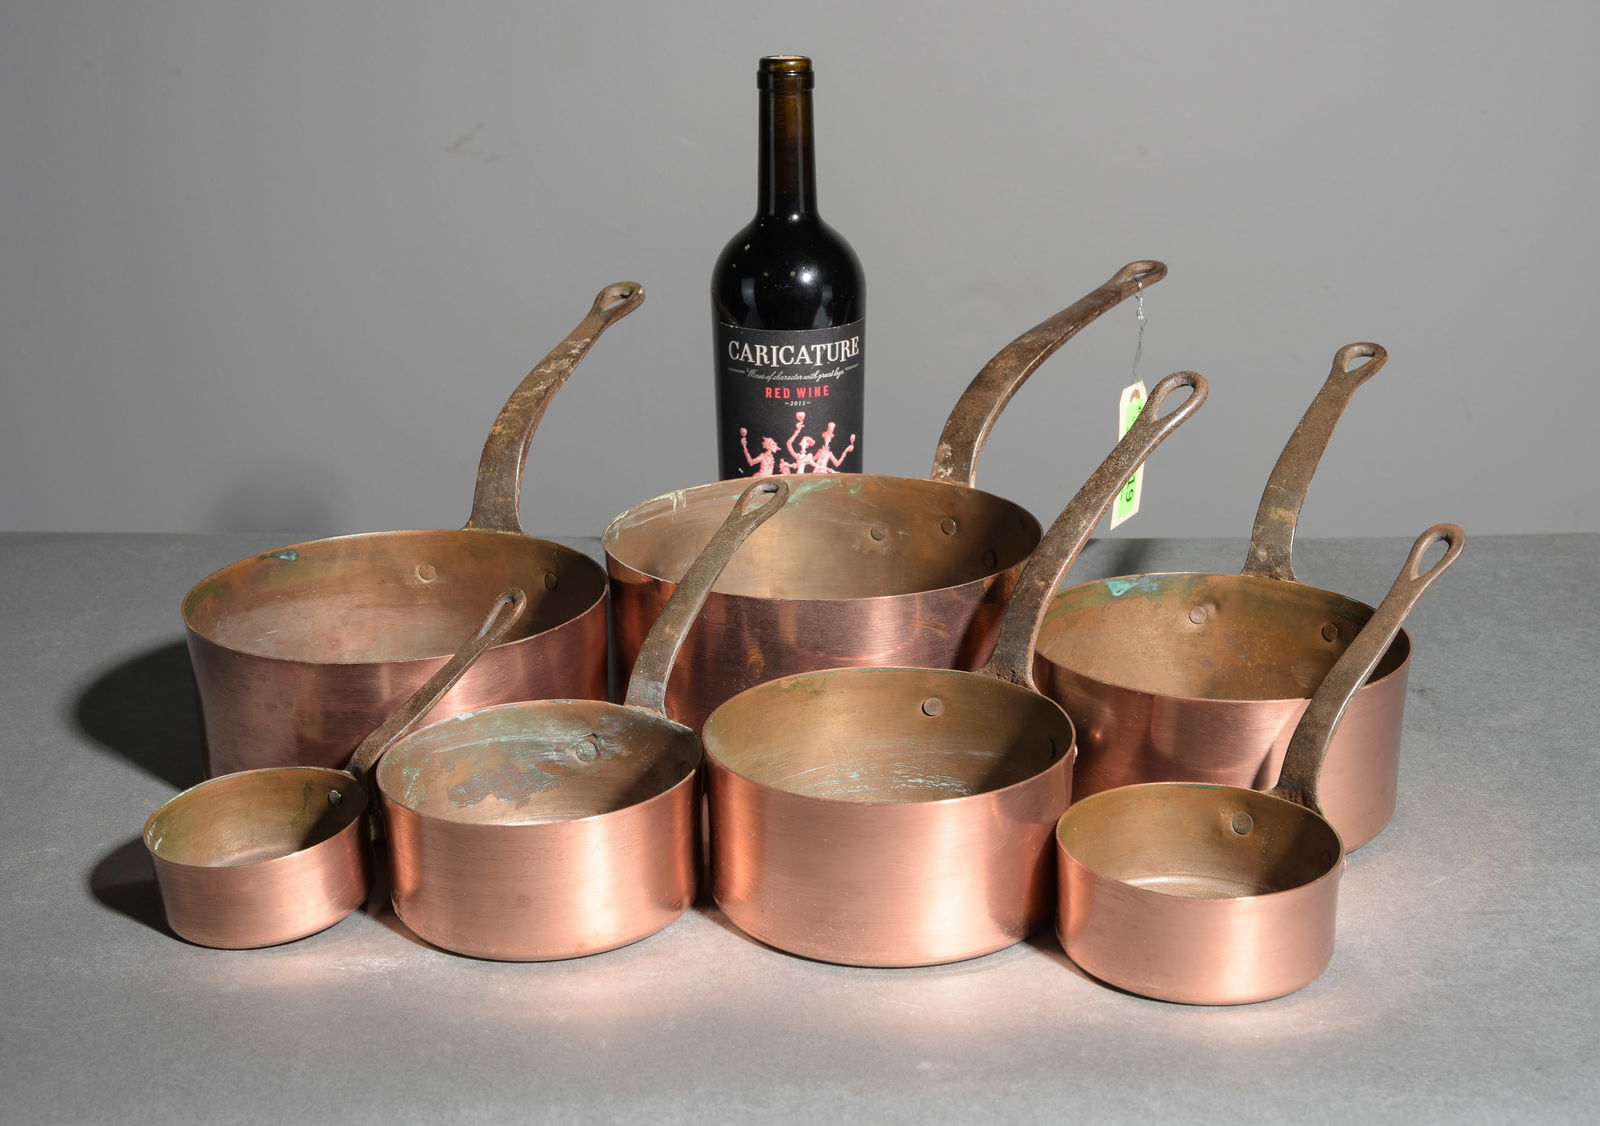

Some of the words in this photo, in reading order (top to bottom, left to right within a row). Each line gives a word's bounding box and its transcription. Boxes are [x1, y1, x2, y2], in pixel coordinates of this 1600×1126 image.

[728, 336, 859, 367] CARICATURE
[746, 368, 765, 379] Wines
[765, 387, 790, 398] RED
[796, 385, 829, 398] WINE
